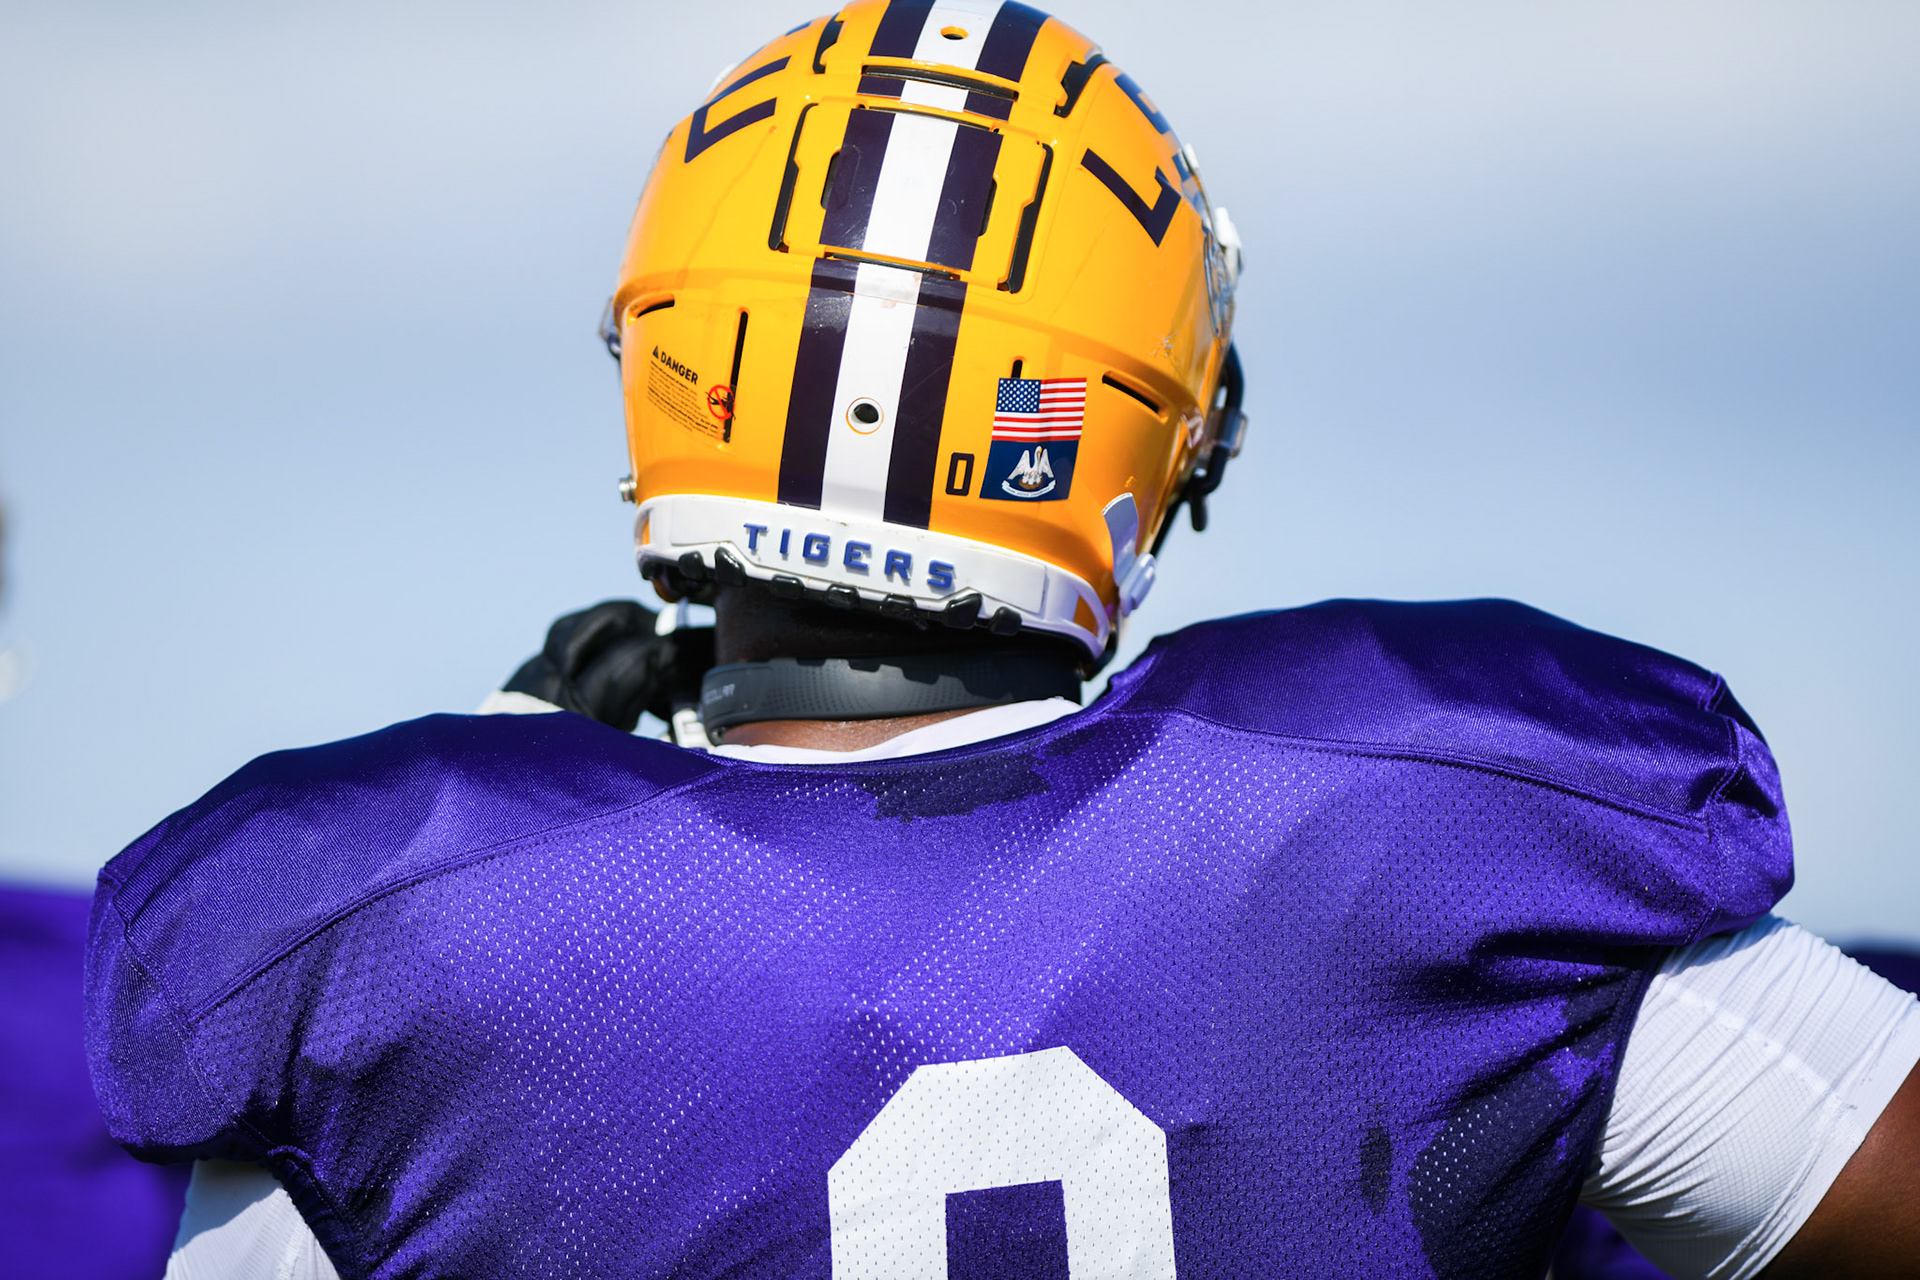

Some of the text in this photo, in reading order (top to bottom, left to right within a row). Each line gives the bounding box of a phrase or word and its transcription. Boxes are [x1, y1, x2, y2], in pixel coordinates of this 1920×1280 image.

[660, 351, 699, 385] DANGER
[945, 452, 975, 496] 0
[743, 522, 955, 589] TIGERS
